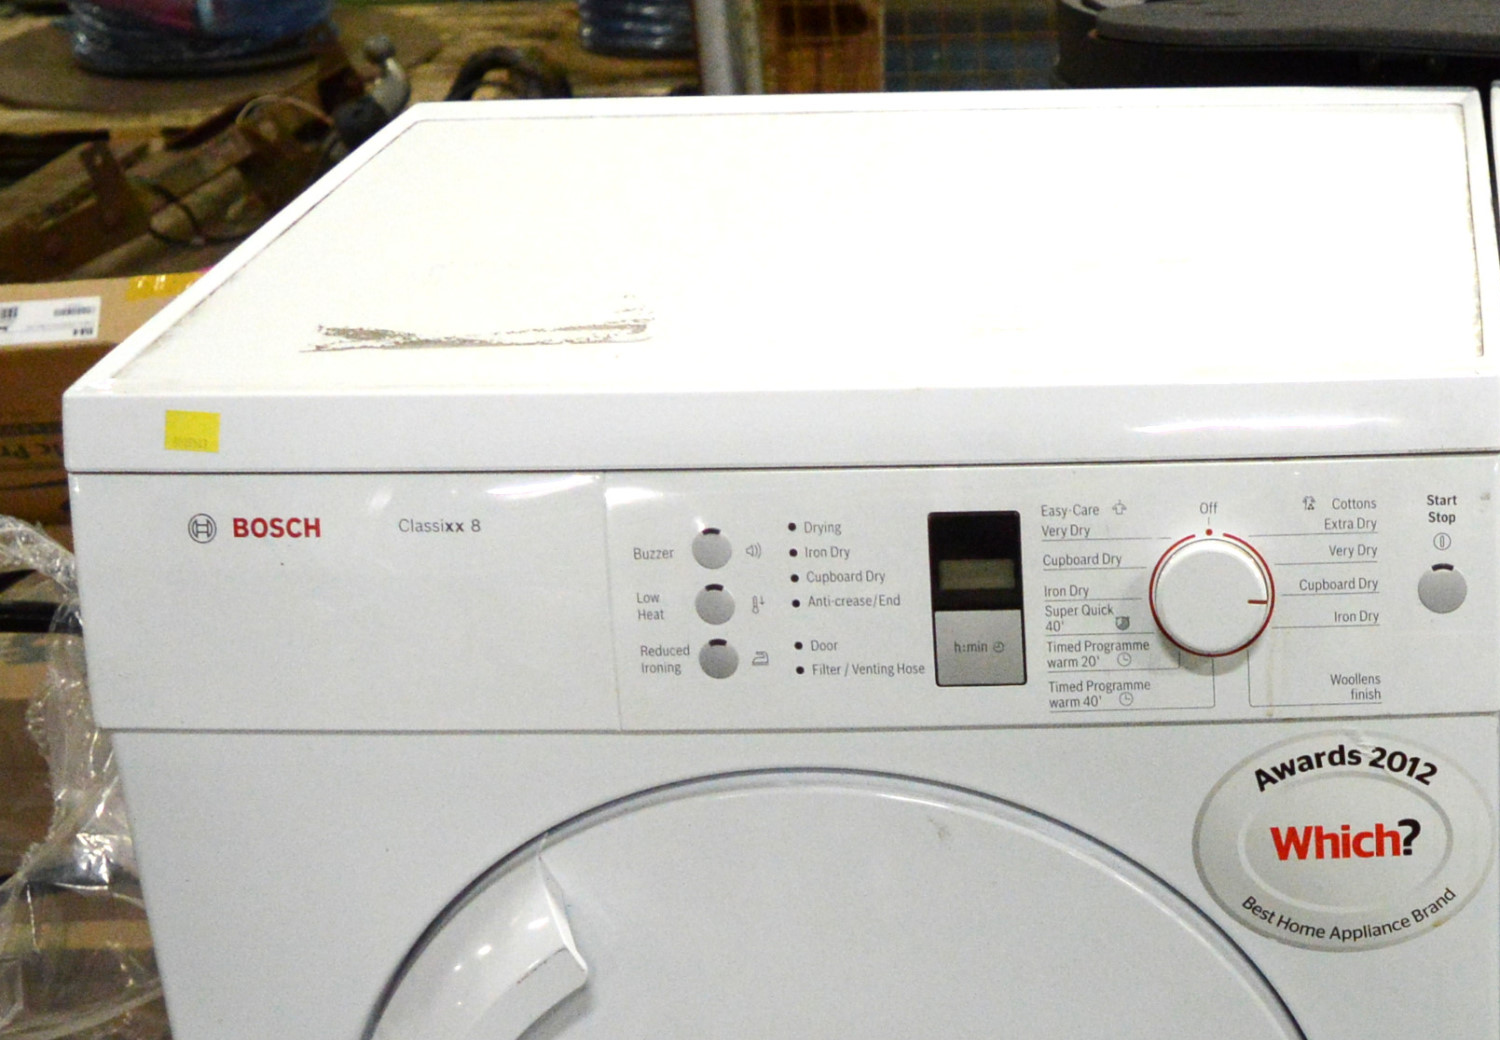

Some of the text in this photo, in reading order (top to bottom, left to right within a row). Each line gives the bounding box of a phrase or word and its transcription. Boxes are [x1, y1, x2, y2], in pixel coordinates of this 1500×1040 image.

[1332, 498, 1377, 510] Cottons
[1427, 494, 1457, 506] Start
[1200, 502, 1218, 514] Off
[1428, 512, 1456, 524] Stop
[233, 518, 321, 538] BOSCH
[399, 519, 481, 533] Classixx 8
[804, 521, 842, 536] Drying
[1324, 518, 1377, 531] Extra Dry
[1041, 525, 1091, 537] Very Dry
[633, 548, 674, 560] Buzzer
[805, 546, 850, 559] Iron Dry
[1329, 545, 1378, 558] Very Dry
[1043, 554, 1122, 568] Cupboard Dry
[806, 570, 886, 584] Cupboard Dry
[1044, 585, 1089, 597] Iron Dry
[1299, 578, 1378, 592] Cupboard Dry
[636, 592, 659, 603] Low
[808, 595, 900, 608] Anti-crease/End
[638, 610, 665, 621] Heat
[1045, 604, 1114, 617] Super Quick
[1334, 611, 1379, 623] Iron Dry
[640, 645, 690, 657] Reduced
[810, 640, 837, 652] Door
[954, 641, 988, 653] h:min
[1047, 640, 1149, 652] Timed Programme
[1047, 657, 1079, 668] warm
[641, 662, 681, 676] Ironing
[812, 664, 841, 676] Filter
[851, 664, 894, 677] Venting
[896, 663, 925, 674] Hose
[1330, 674, 1381, 685] Woollens
[1049, 679, 1150, 693] Timed Programme
[1350, 688, 1382, 700] finish
[1049, 697, 1081, 708] warm
[1254, 744, 1437, 792] Awards 2012
[1270, 818, 1421, 861] Which?
[1242, 888, 1456, 942] Best Home Appliance Brand
